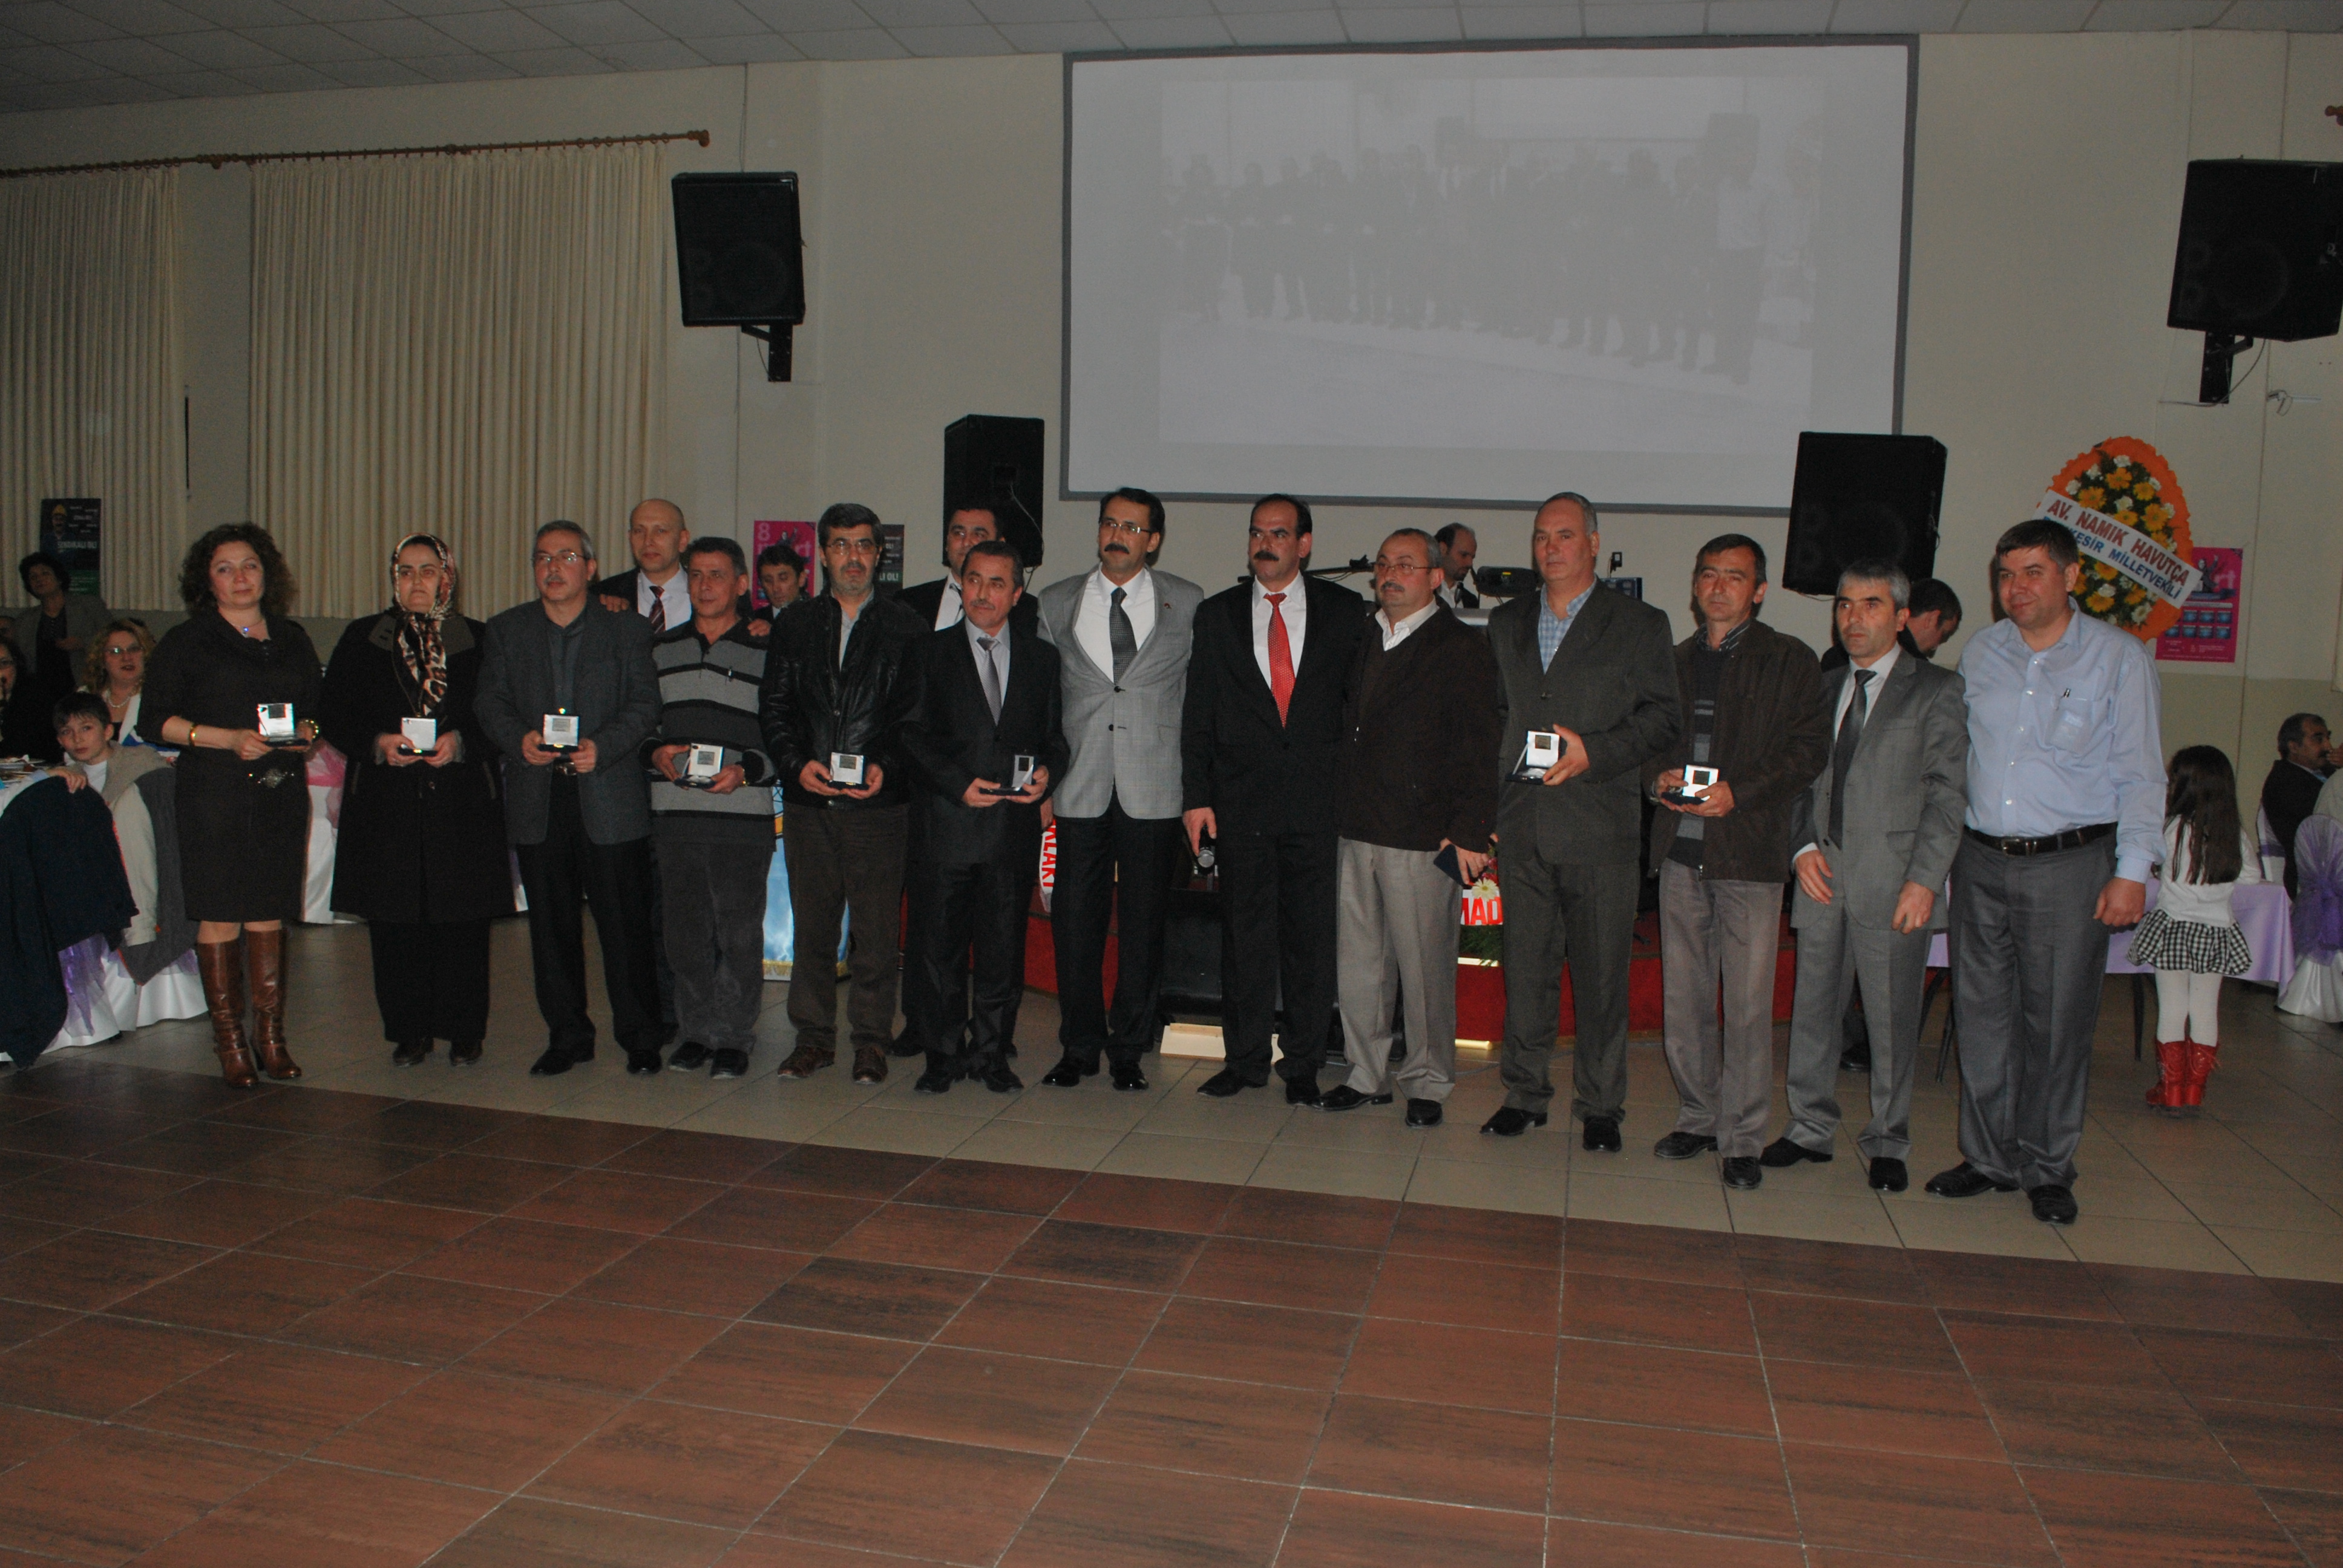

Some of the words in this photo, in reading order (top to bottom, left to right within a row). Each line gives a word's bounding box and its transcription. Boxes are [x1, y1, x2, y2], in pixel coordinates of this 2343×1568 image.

[758, 521, 770, 541] 8
[2047, 500, 2073, 520] AV.
[2076, 511, 2129, 547] NAMIK
[2130, 538, 2190, 586] HAVUTÇA
[2108, 548, 2182, 599] MİLLETVEKİLİ
